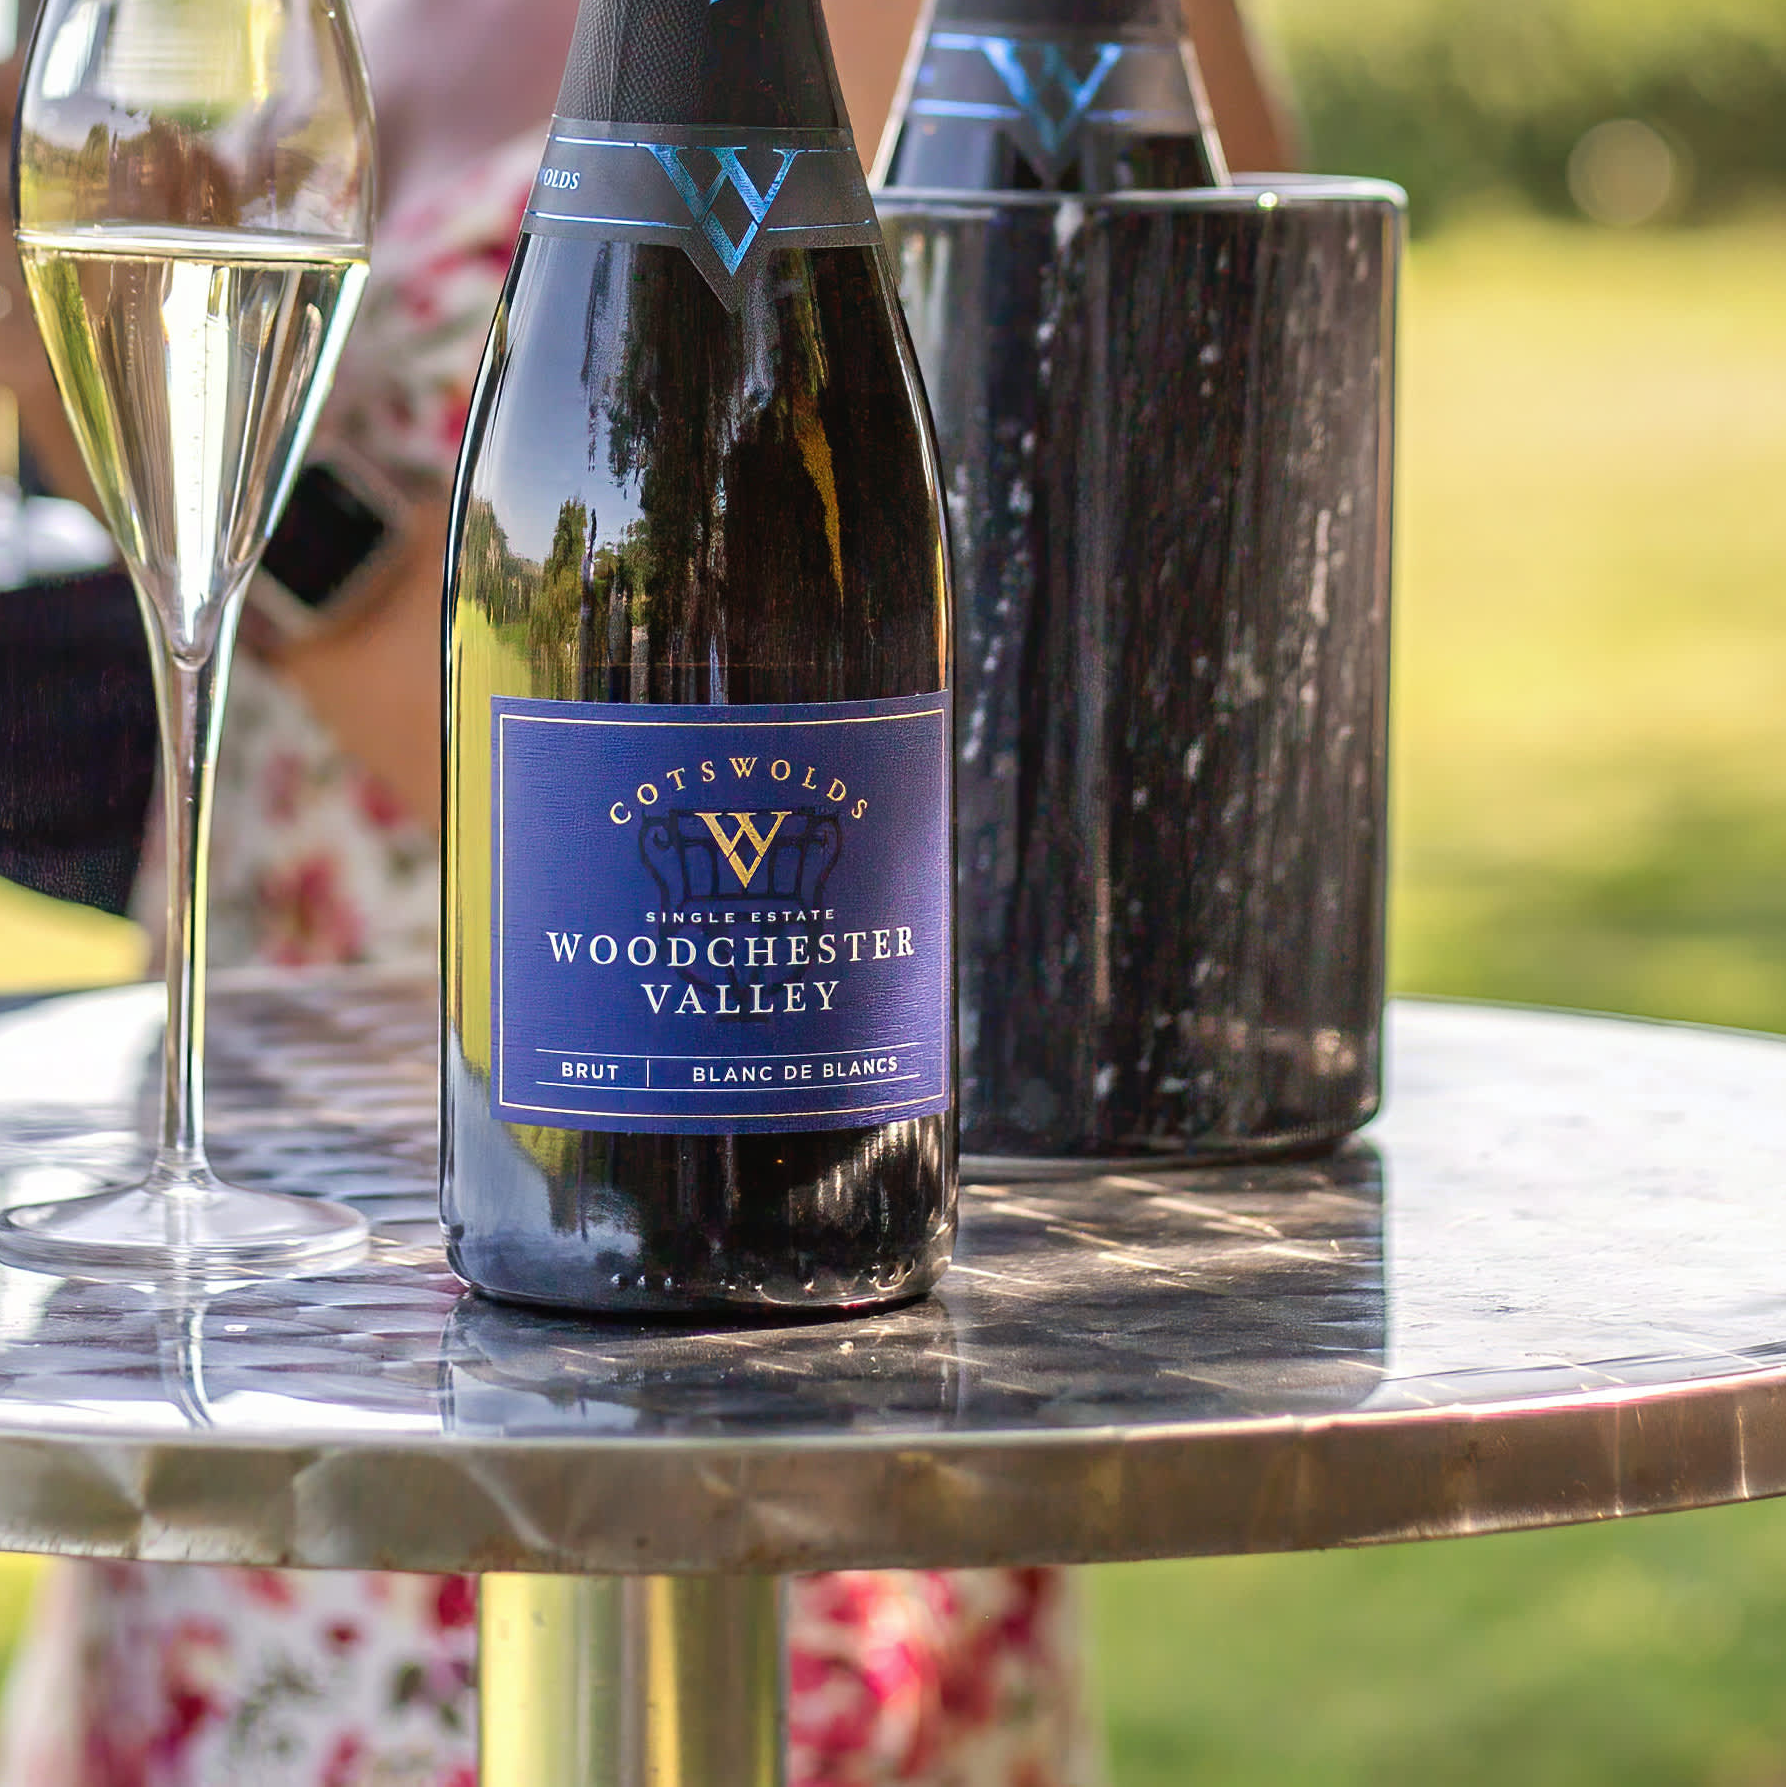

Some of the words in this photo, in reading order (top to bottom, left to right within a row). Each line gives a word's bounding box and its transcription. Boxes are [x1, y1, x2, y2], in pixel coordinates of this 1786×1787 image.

[609, 756, 868, 825] COTSWOLDS
[645, 911, 735, 924] SINGLE
[751, 909, 835, 923] ESTATE
[546, 926, 915, 967] WOODCHESTER
[641, 980, 841, 1014] VALLEY
[561, 1061, 619, 1081] BRUT
[693, 1065, 772, 1083] BLANC
[785, 1063, 813, 1081] DE
[823, 1056, 898, 1079] BLANCS
